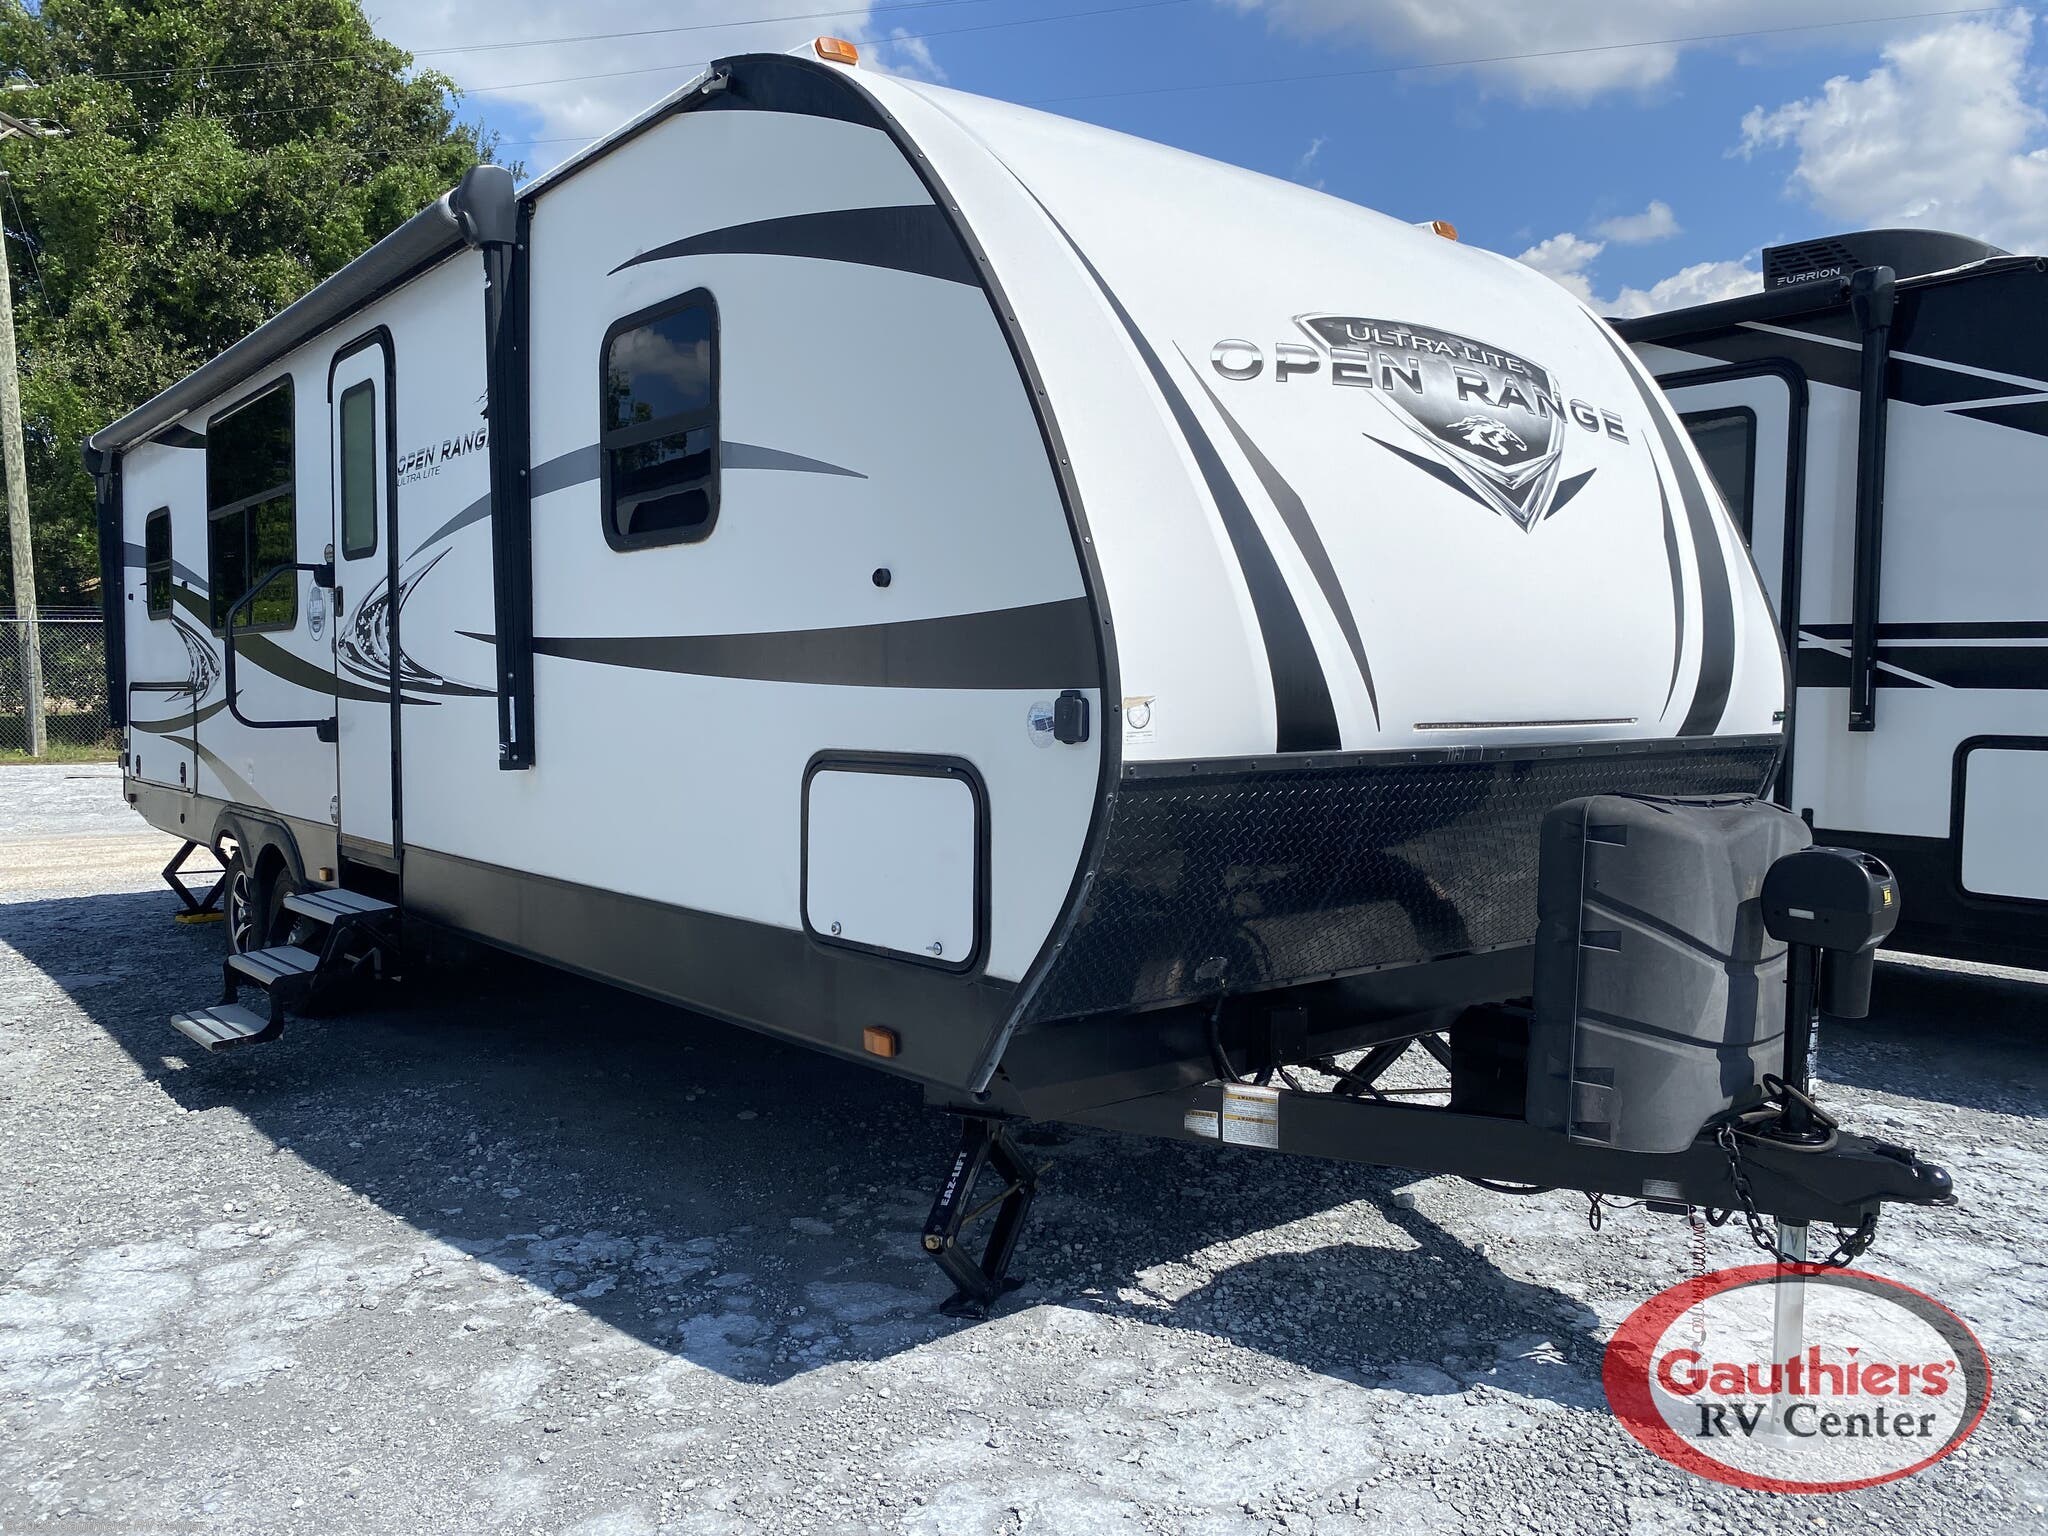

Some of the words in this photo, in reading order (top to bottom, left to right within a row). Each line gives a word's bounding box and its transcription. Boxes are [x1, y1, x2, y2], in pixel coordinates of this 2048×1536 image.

[1777, 266, 1841, 285] FURRION
[1345, 323, 1456, 357] ULTRA
[1465, 349, 1524, 372] LITE
[1210, 338, 1424, 394] OPEN
[1453, 366, 1630, 445] RANGE
[397, 444, 435, 476] OPEN
[397, 473, 421, 487] ULTRA
[423, 465, 440, 479] LITE
[940, 1151, 968, 1207] EAZ-LIFT
